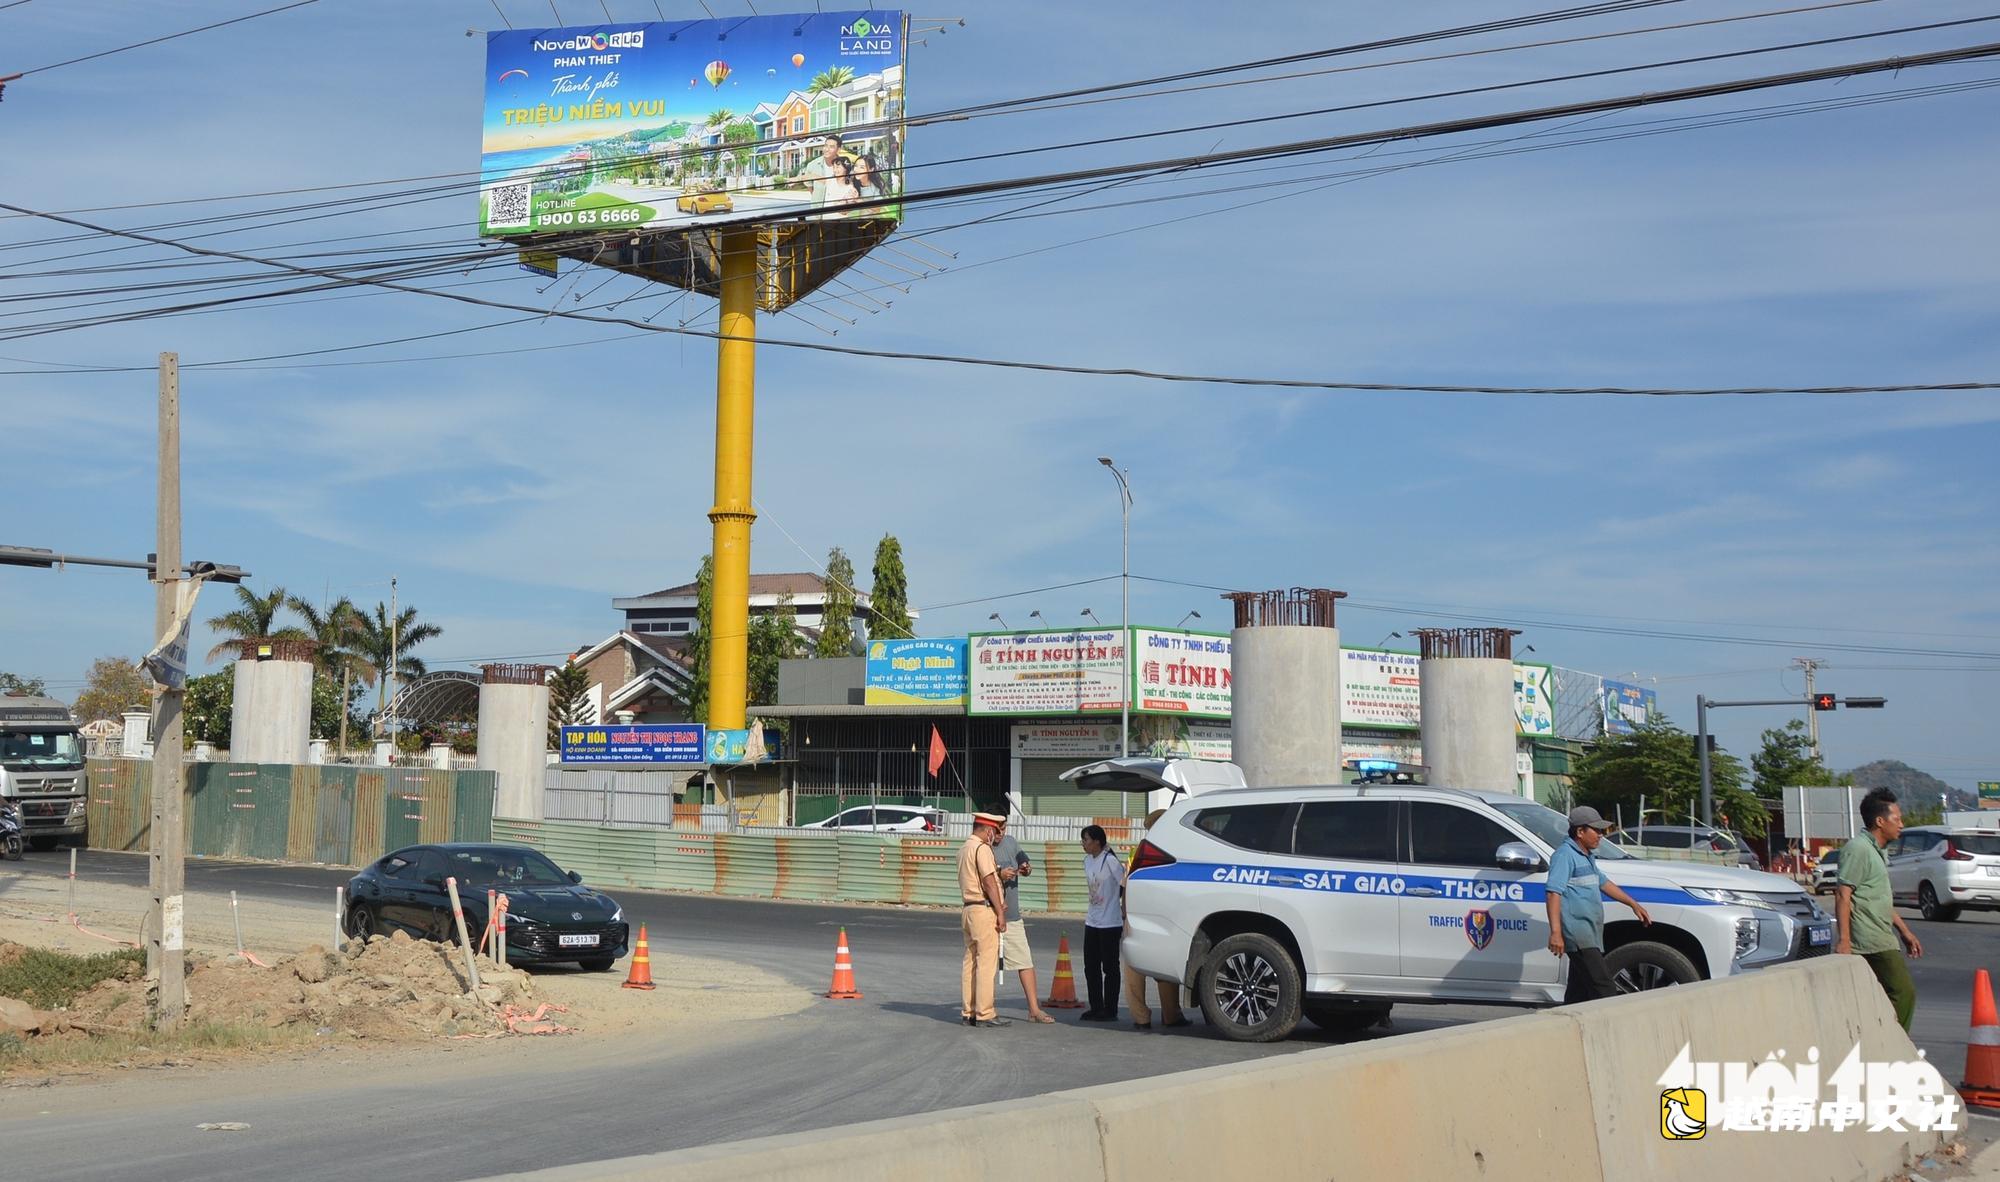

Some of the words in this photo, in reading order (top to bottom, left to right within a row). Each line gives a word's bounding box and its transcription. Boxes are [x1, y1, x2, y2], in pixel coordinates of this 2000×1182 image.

[841, 40, 892, 50] LAND
[554, 56, 585, 68] PHAN
[588, 54, 621, 65] THIET
[551, 74, 592, 97] Thành
[587, 71, 619, 102] phố
[503, 103, 564, 127] TRIỆU
[569, 97, 621, 121] NIỀM
[628, 99, 665, 116] VUI
[536, 200, 577, 209] HOTLINE
[538, 212, 573, 225] 1900
[577, 211, 596, 223] 63
[600, 209, 640, 222] 6666
[987, 637, 1001, 645] CÔNG
[1148, 634, 1169, 648] CÔNG
[1171, 639, 1181, 649] TY
[1184, 640, 1203, 652] TNHH
[1205, 640, 1225, 653] CHIẾU
[996, 646, 1037, 664] TÍNH
[1042, 641, 1108, 661] NGUYỄN
[924, 656, 955, 669] Minh
[1143, 660, 1160, 684] 信
[1165, 658, 1217, 688] TÍNH
[566, 732, 584, 747] TẠP
[587, 730, 607, 744] HÓA
[611, 727, 639, 745] NGUYỄN
[640, 732, 652, 746] THỊ
[653, 732, 673, 746] NGỌC
[673, 731, 698, 744] TRANG
[1212, 866, 1270, 884] CẢNH
[1303, 872, 1346, 891] SÁT
[1354, 876, 1406, 895] GIAO
[1441, 879, 1524, 901] THÔNG
[1429, 916, 1463, 928] TRAFFIC
[1496, 919, 1528, 931] POLICE
